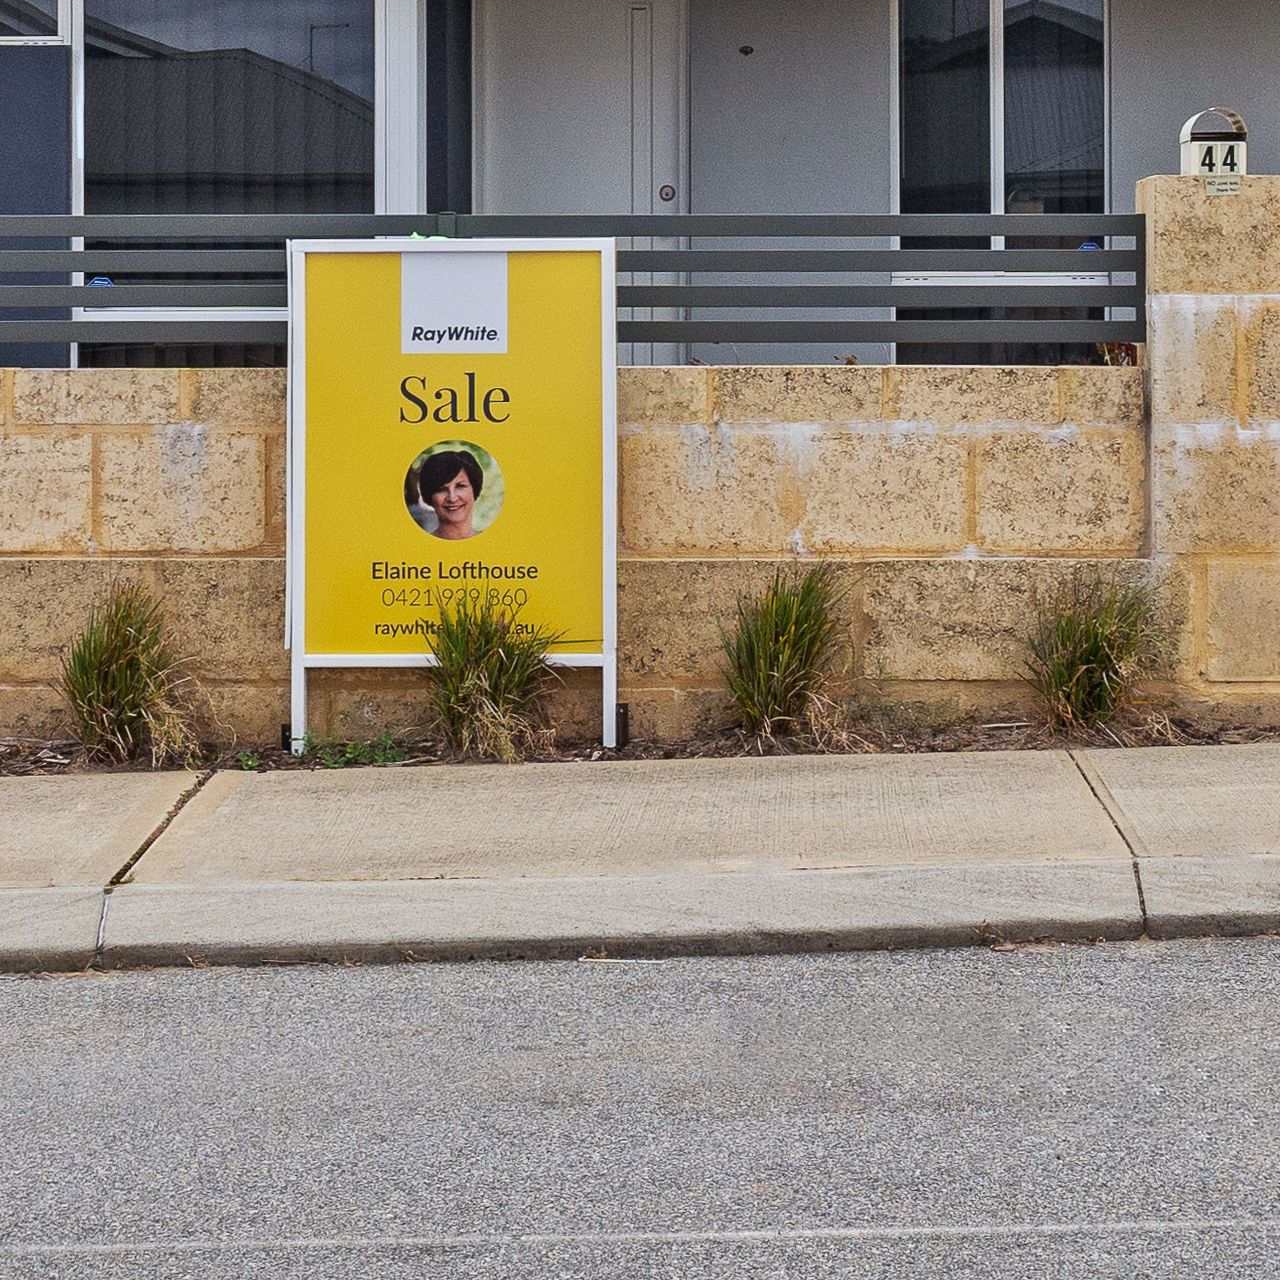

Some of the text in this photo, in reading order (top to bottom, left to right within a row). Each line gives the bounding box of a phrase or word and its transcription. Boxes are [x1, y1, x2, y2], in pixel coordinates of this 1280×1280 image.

[1201, 145, 1237, 173] 44
[400, 372, 510, 424] Sale
[372, 561, 538, 580] Elaine Lofthouse
[381, 588, 434, 607] 0421
[489, 588, 527, 607] 860
